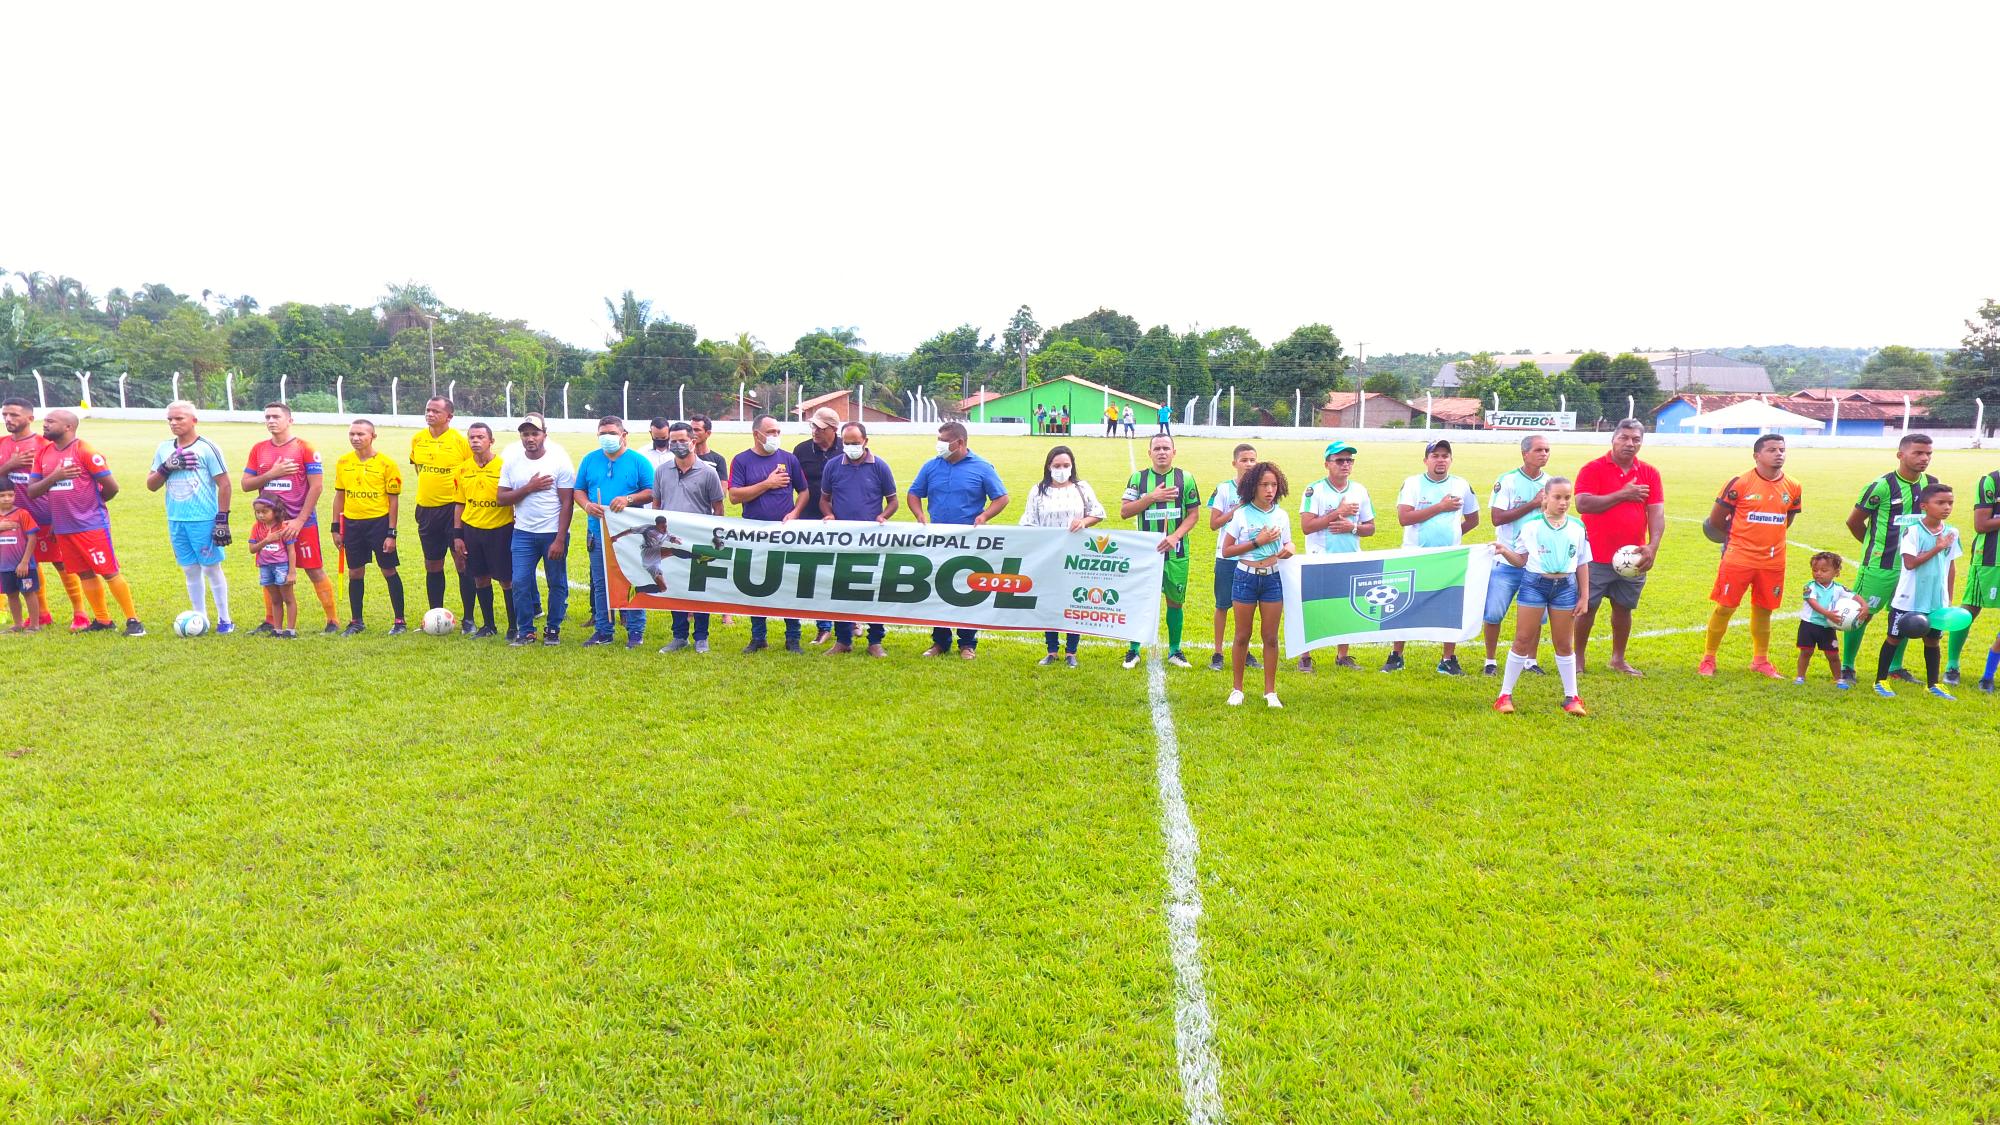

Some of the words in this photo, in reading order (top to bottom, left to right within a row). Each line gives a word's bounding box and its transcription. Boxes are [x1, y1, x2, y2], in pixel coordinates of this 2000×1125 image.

[1498, 416, 1556, 426] FUTEBOL
[712, 526, 853, 547] CAMPEONATO
[858, 531, 971, 550] MUNICIPAL
[976, 536, 1005, 551] DE
[91, 551, 106, 565] 13
[301, 545, 312, 559] 11
[1063, 554, 1131, 573] Nazaré
[688, 543, 1038, 610] FUTEBOL
[978, 576, 1022, 589] 2021
[1369, 605, 1377, 615] E
[1384, 603, 1395, 613] C
[1064, 608, 1126, 625] ESPORTE
